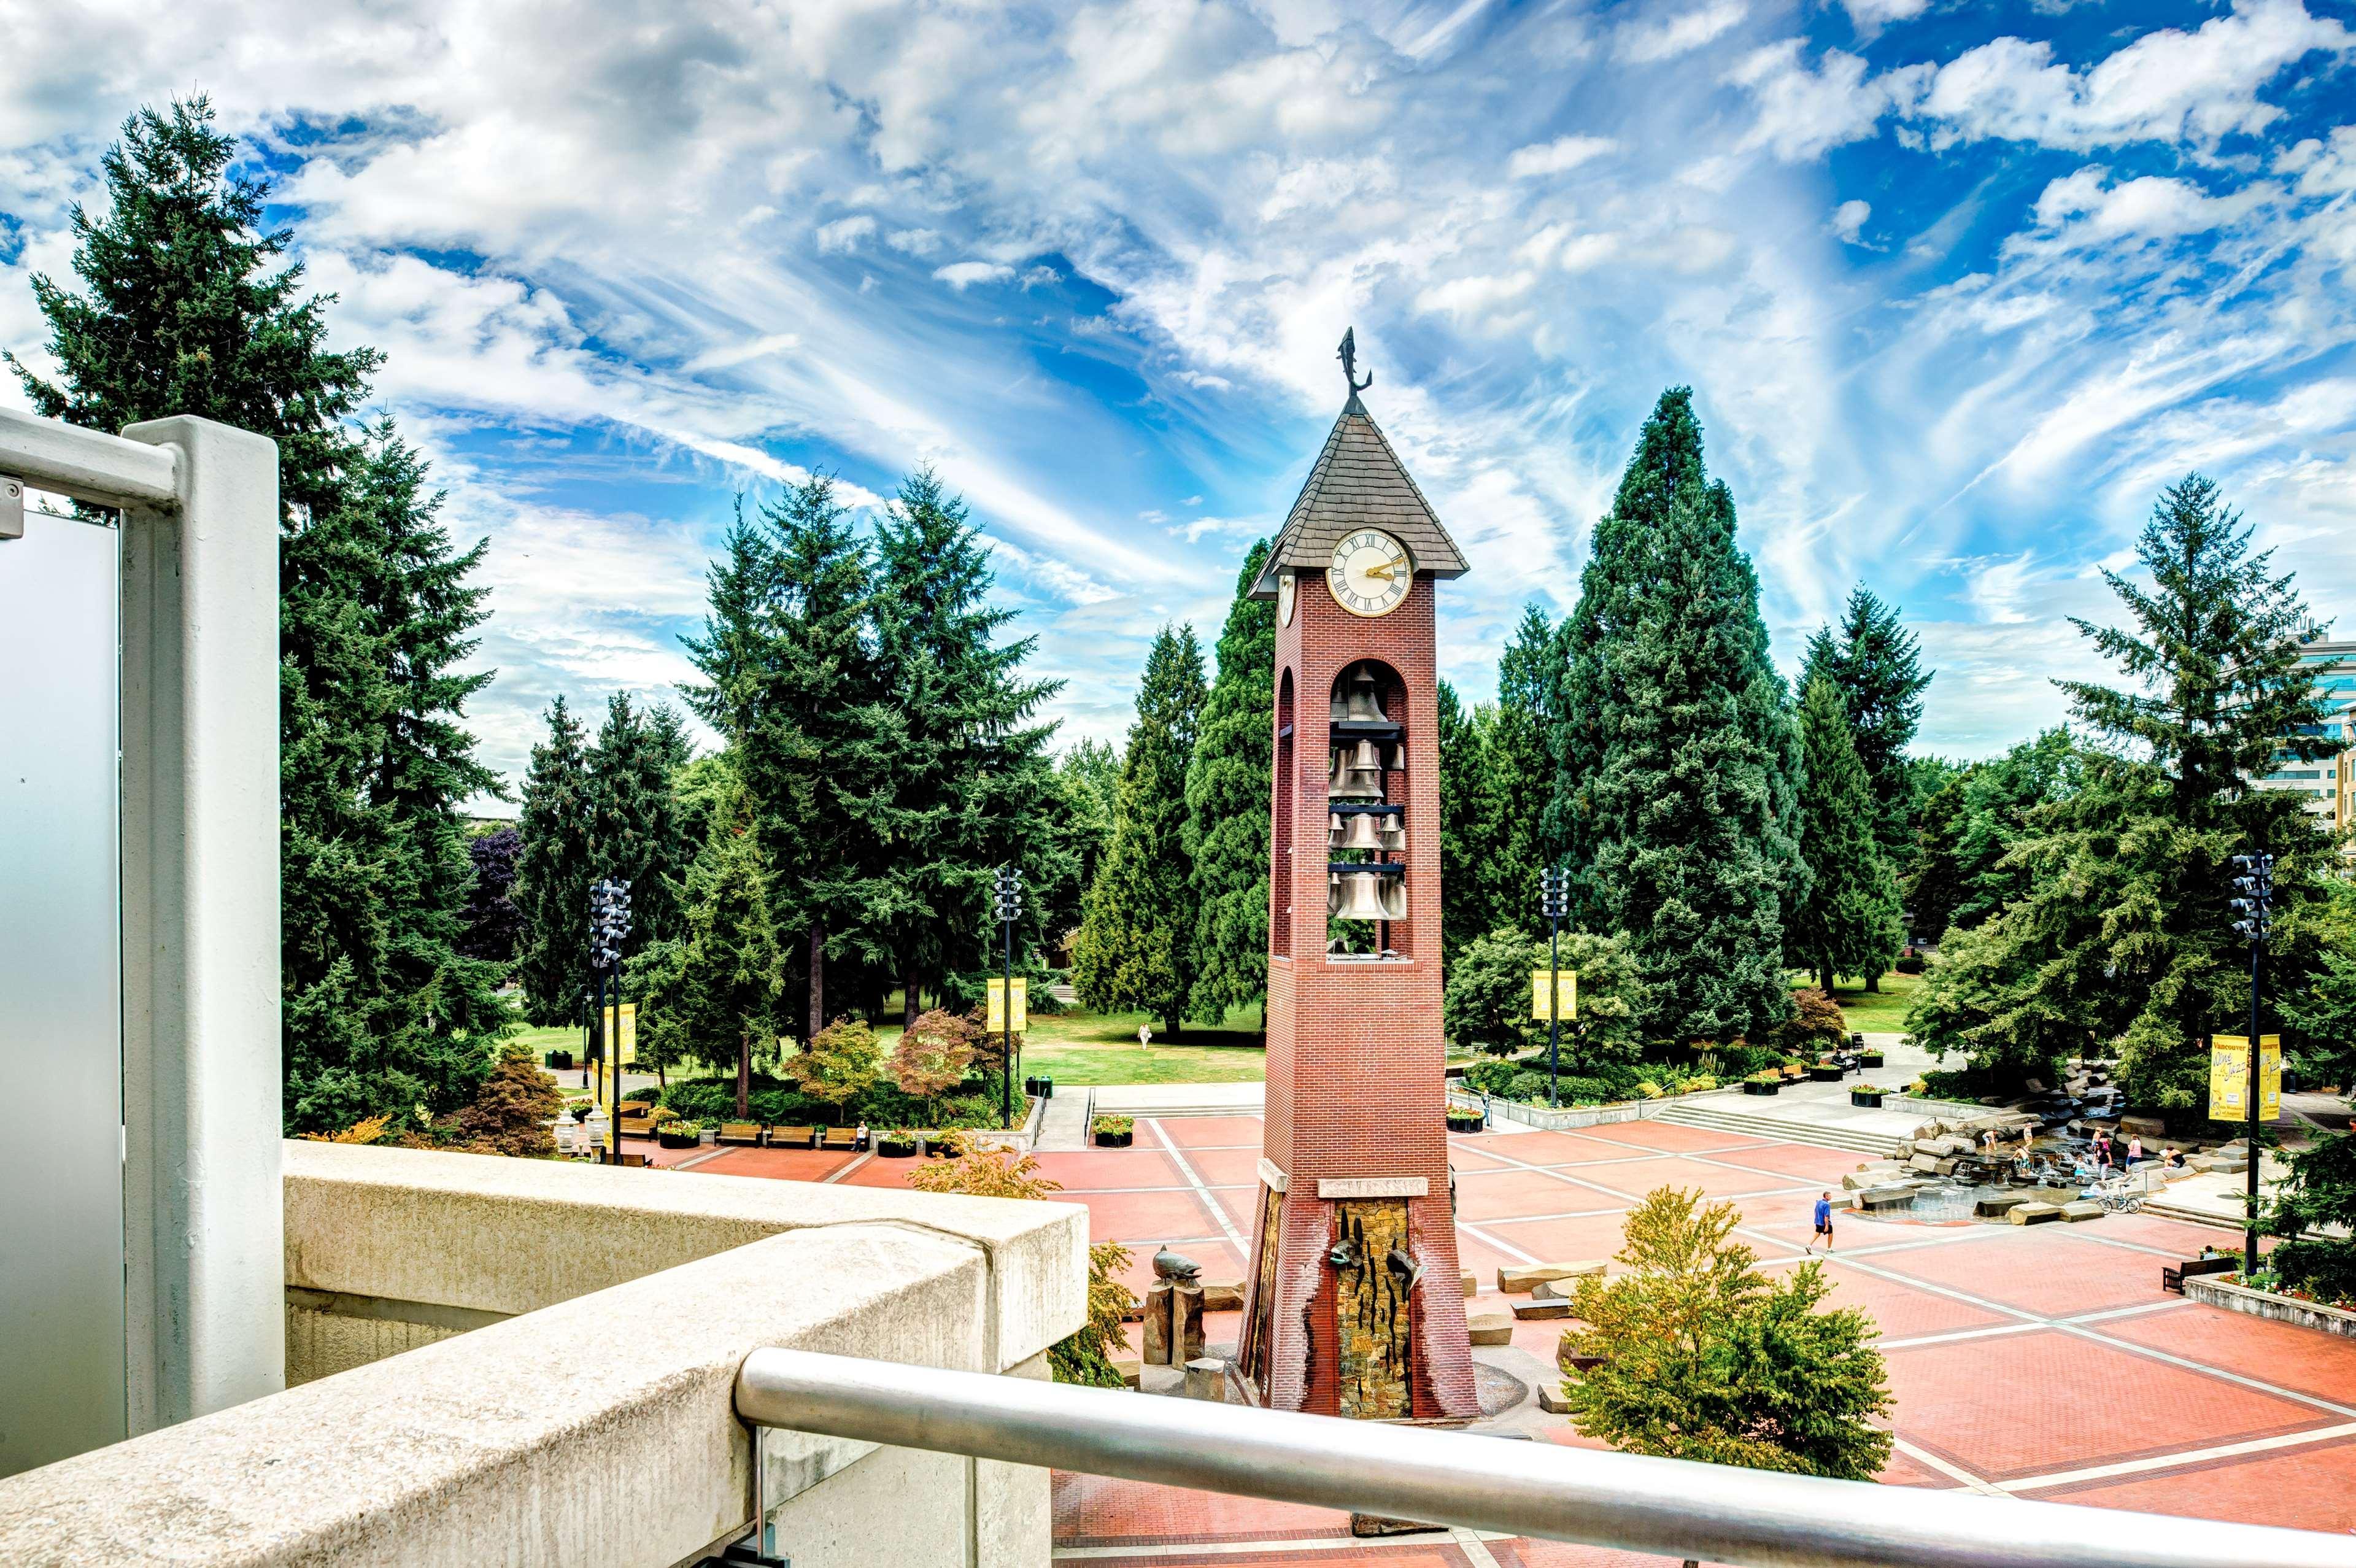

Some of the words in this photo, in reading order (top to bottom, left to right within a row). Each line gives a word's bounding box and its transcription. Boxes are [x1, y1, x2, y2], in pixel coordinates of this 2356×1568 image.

[1348, 537, 1360, 551] XI
[1365, 534, 1375, 547] XII
[1336, 550, 1348, 560] X
[1334, 579, 1349, 595] VIII
[1346, 592, 1358, 607] VII
[1364, 598, 1372, 611] VI
[1380, 595, 1389, 607] V
[2213, 1042, 2246, 1051] Vancouver
[2224, 1062, 2246, 1081] Jazz
